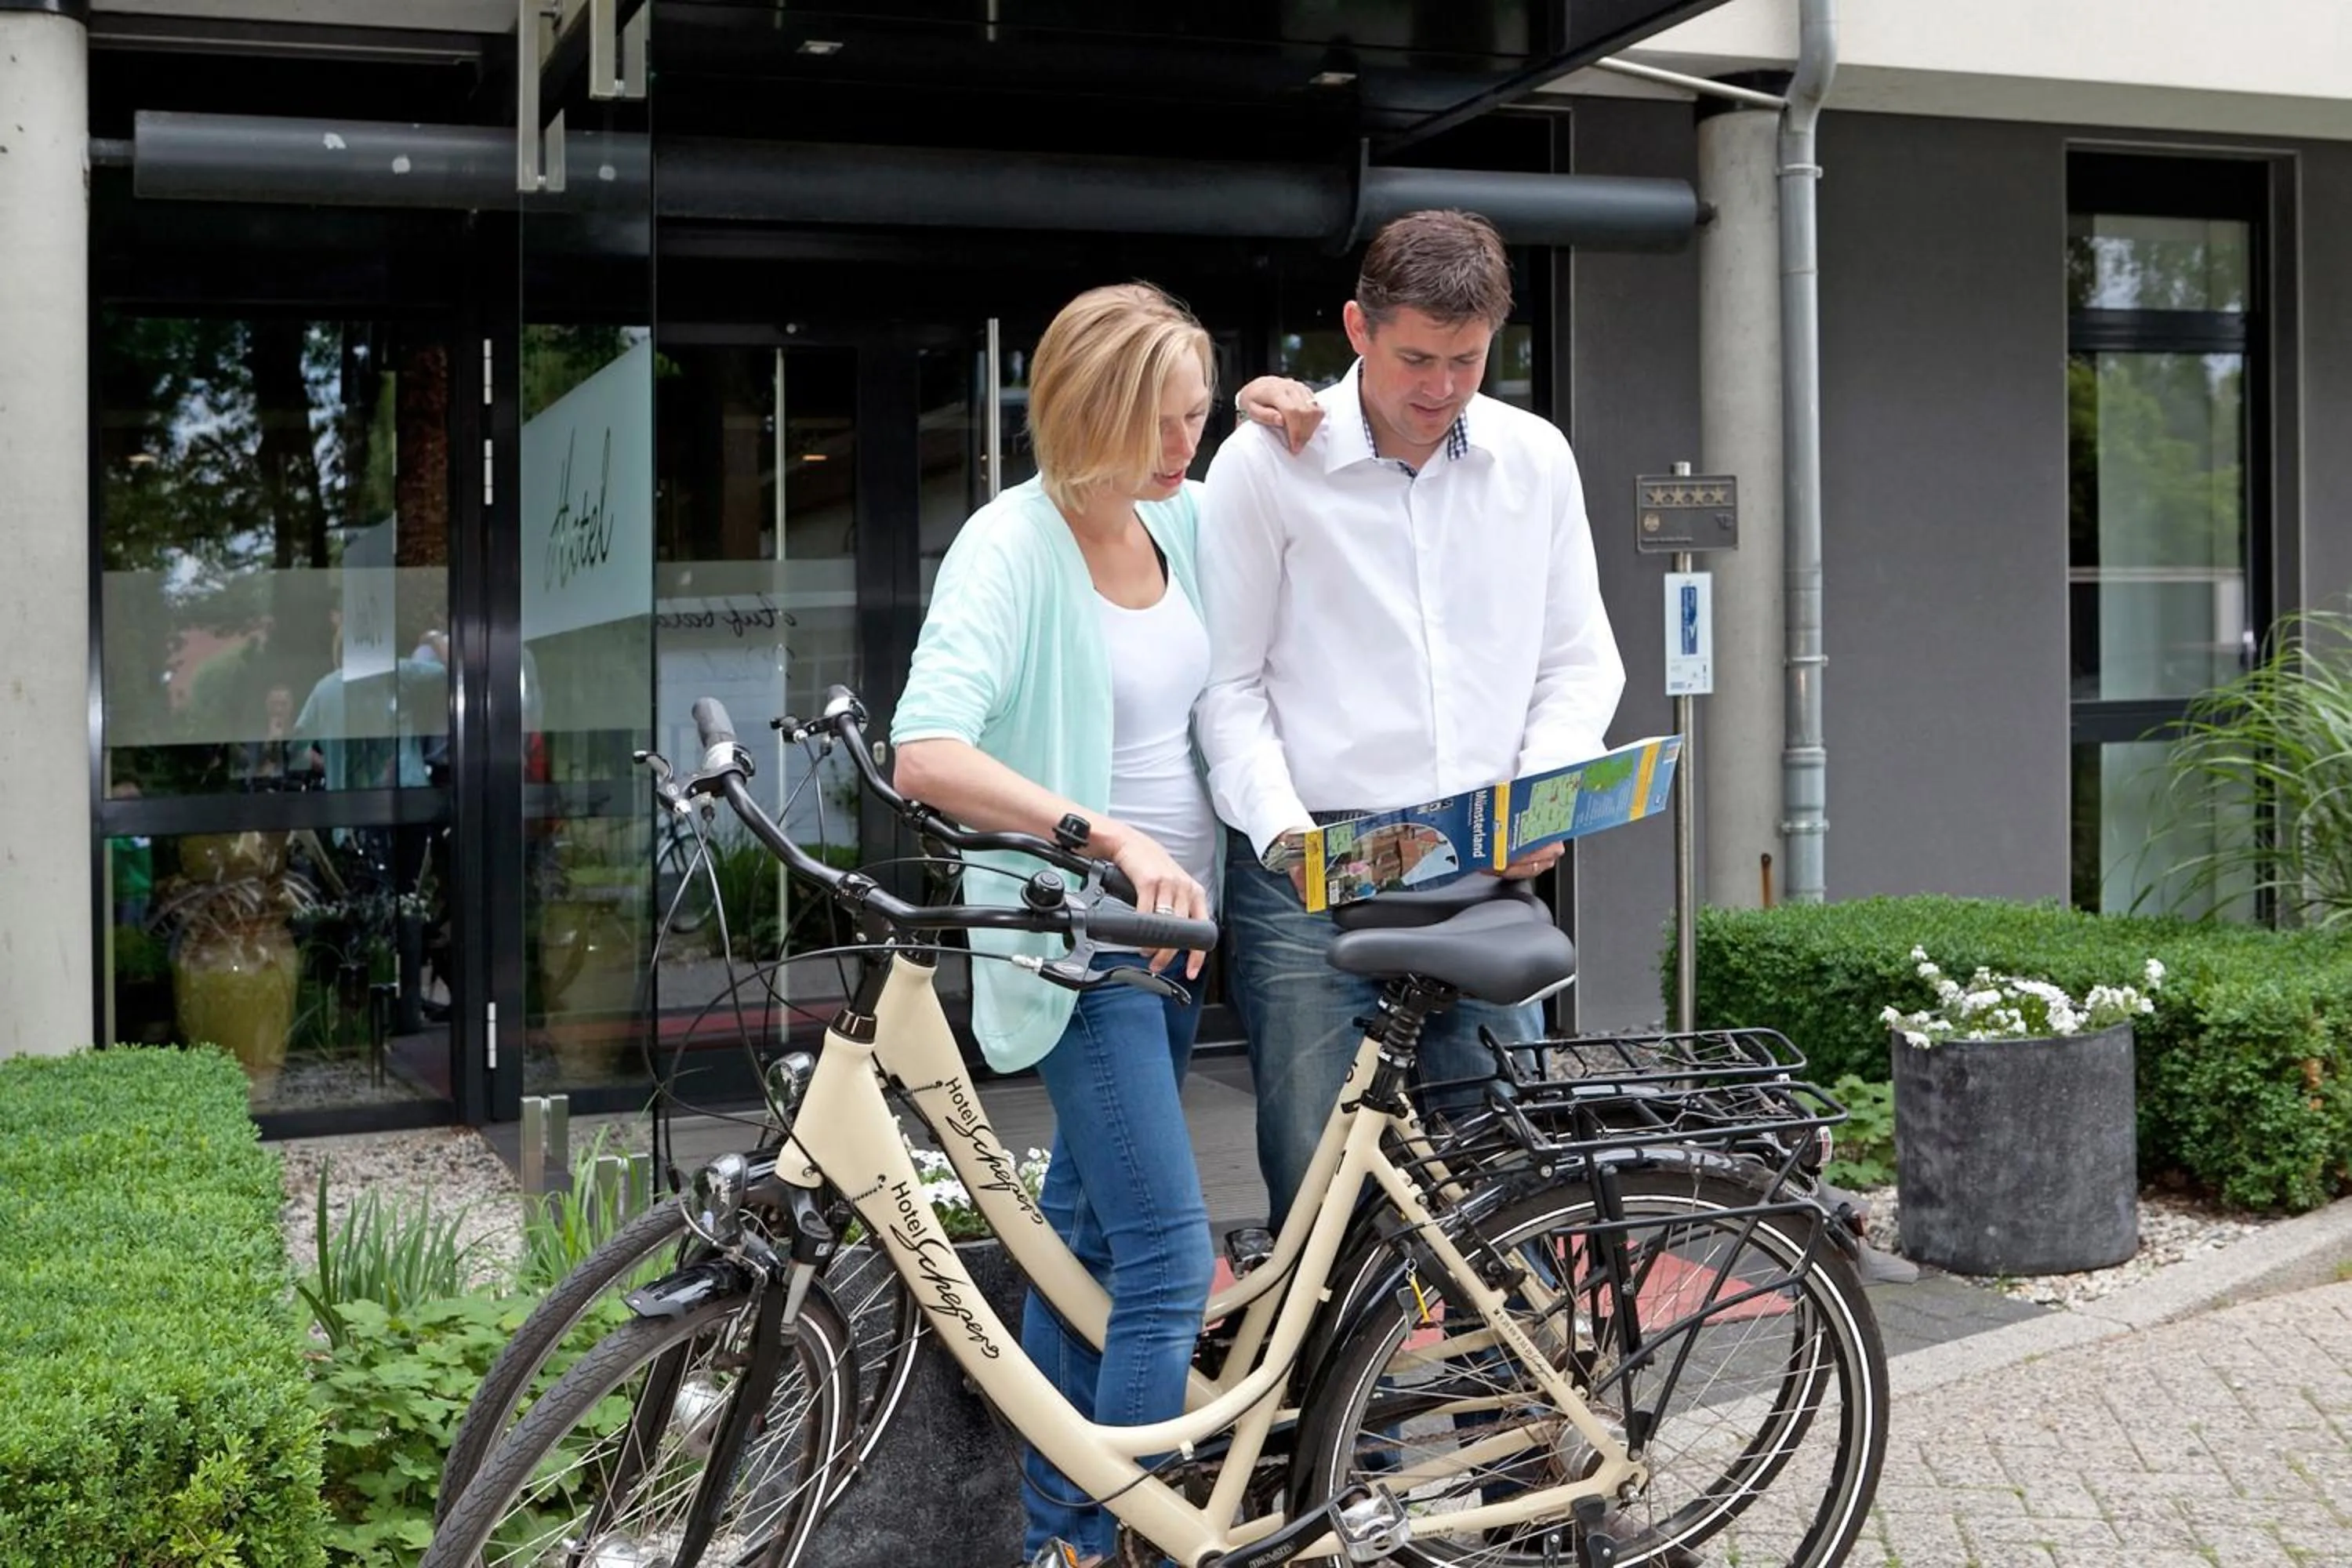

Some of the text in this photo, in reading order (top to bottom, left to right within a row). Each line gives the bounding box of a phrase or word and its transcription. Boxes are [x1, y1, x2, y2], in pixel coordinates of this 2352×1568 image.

[544, 426, 613, 593] Hotel
[1471, 789, 1487, 859] Münsterland
[945, 1076, 978, 1126] Hotel
[891, 1181, 928, 1239] Hotel
